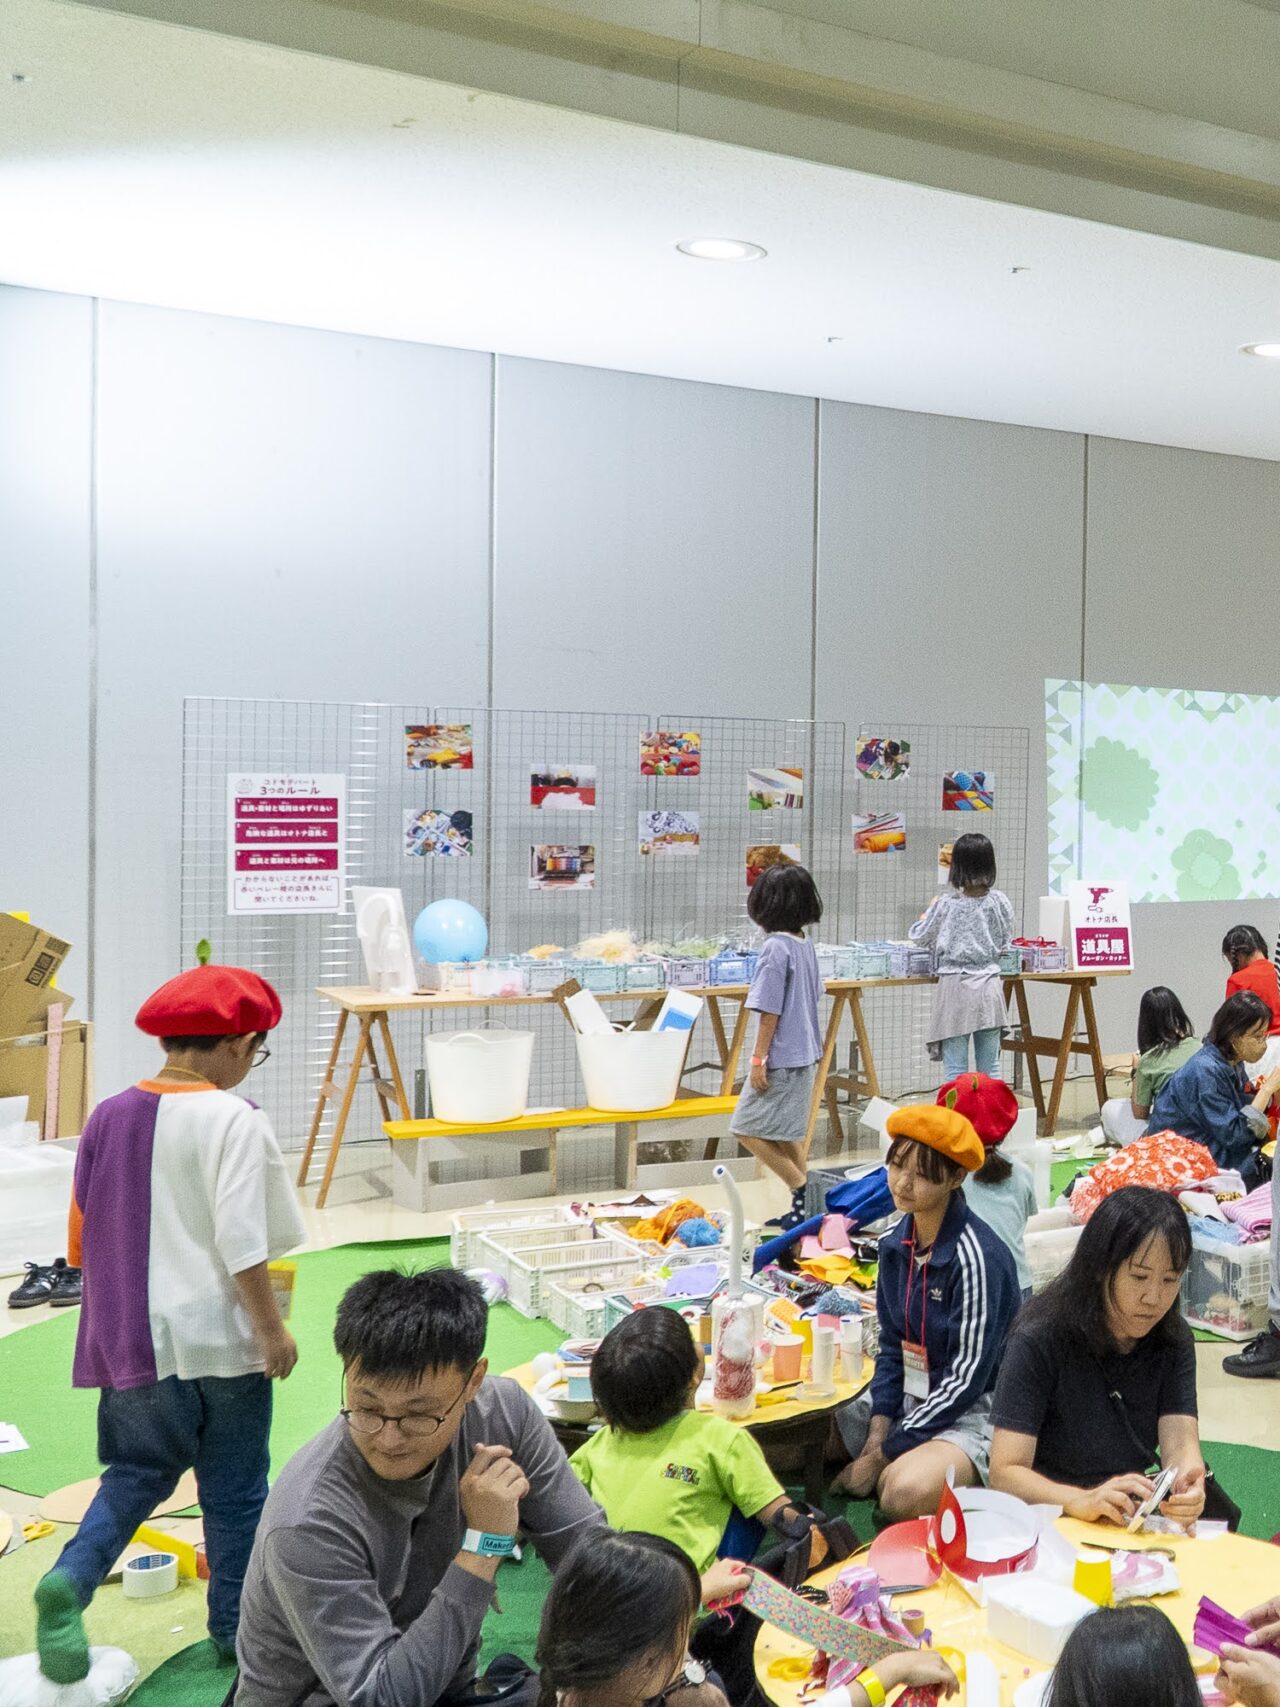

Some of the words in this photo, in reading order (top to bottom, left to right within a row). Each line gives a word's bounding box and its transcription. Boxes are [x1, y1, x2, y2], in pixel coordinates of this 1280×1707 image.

[260, 787, 320, 796] 3つのルール
[1086, 915, 1118, 923] オトナ店長
[1081, 938, 1125, 955] 道具屋
